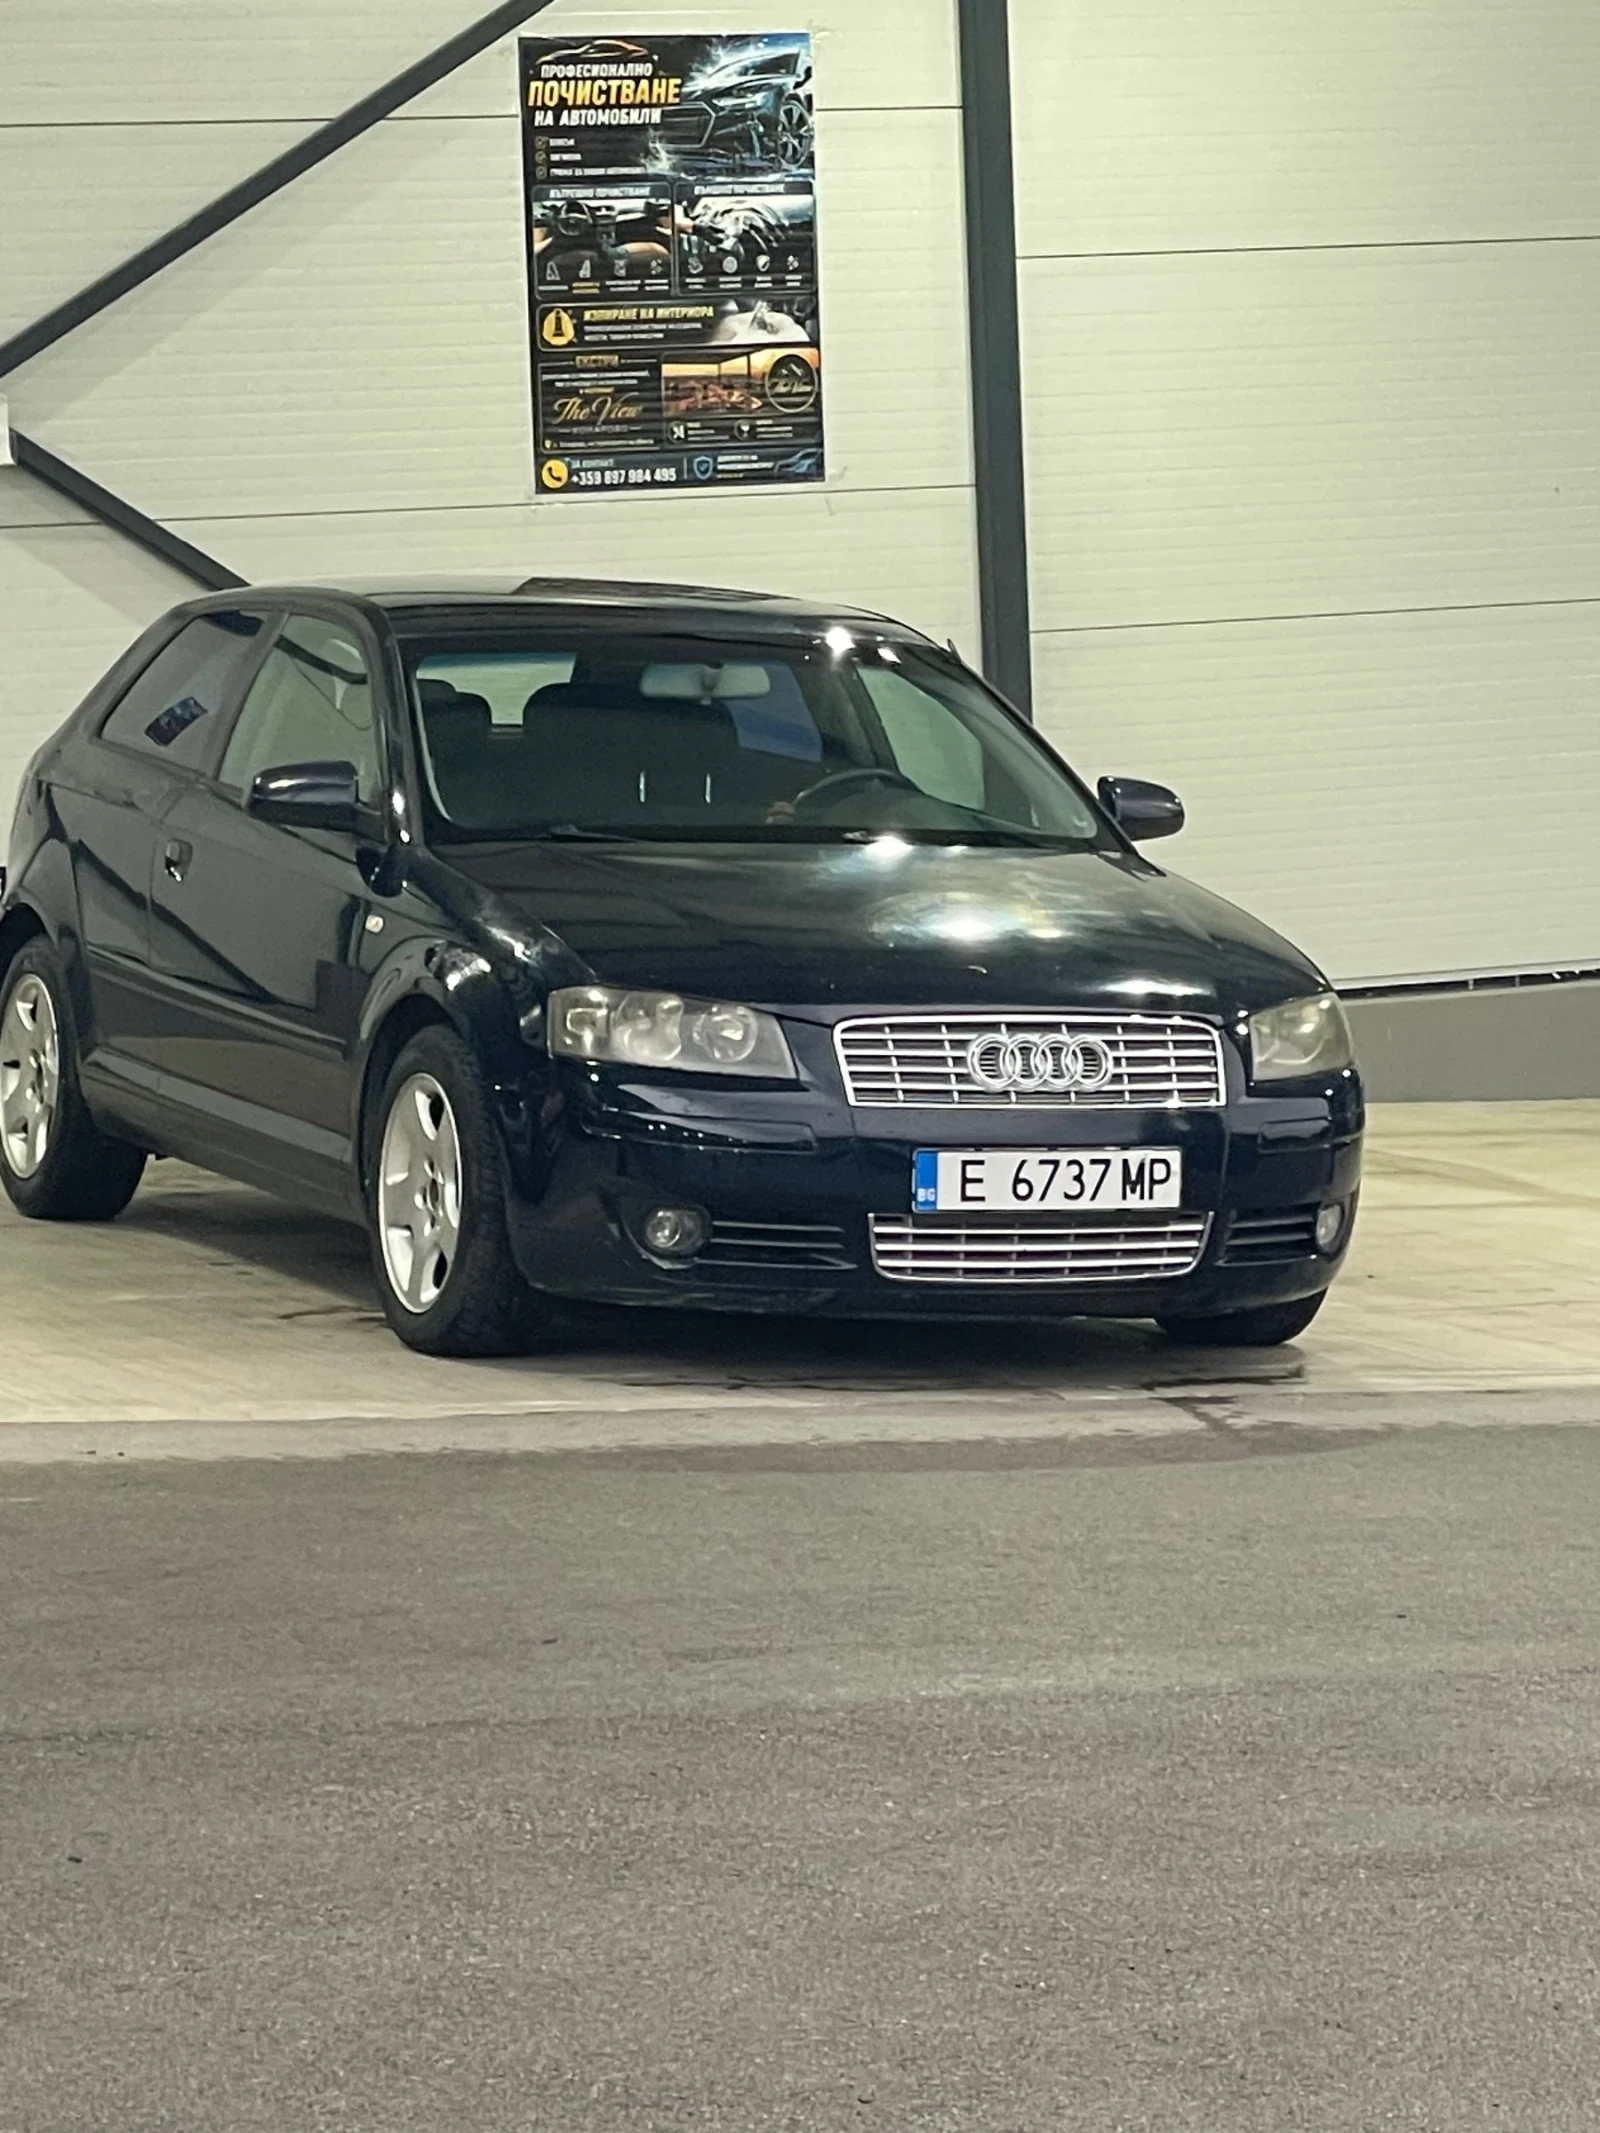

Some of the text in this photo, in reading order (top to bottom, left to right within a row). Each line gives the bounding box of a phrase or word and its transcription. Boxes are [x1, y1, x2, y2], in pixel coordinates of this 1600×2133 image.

[541, 63, 653, 78] ПРОФЕСИОНАЛНО
[528, 78, 682, 106] ПОЧИСТВАНЕ
[534, 108, 662, 126] НА АВТОМОБИЛИ
[552, 392, 643, 427] The View
[571, 470, 602, 486] +359
[960, 1157, 1172, 1202] E 6737 MP
[917, 1188, 936, 1201] BG
